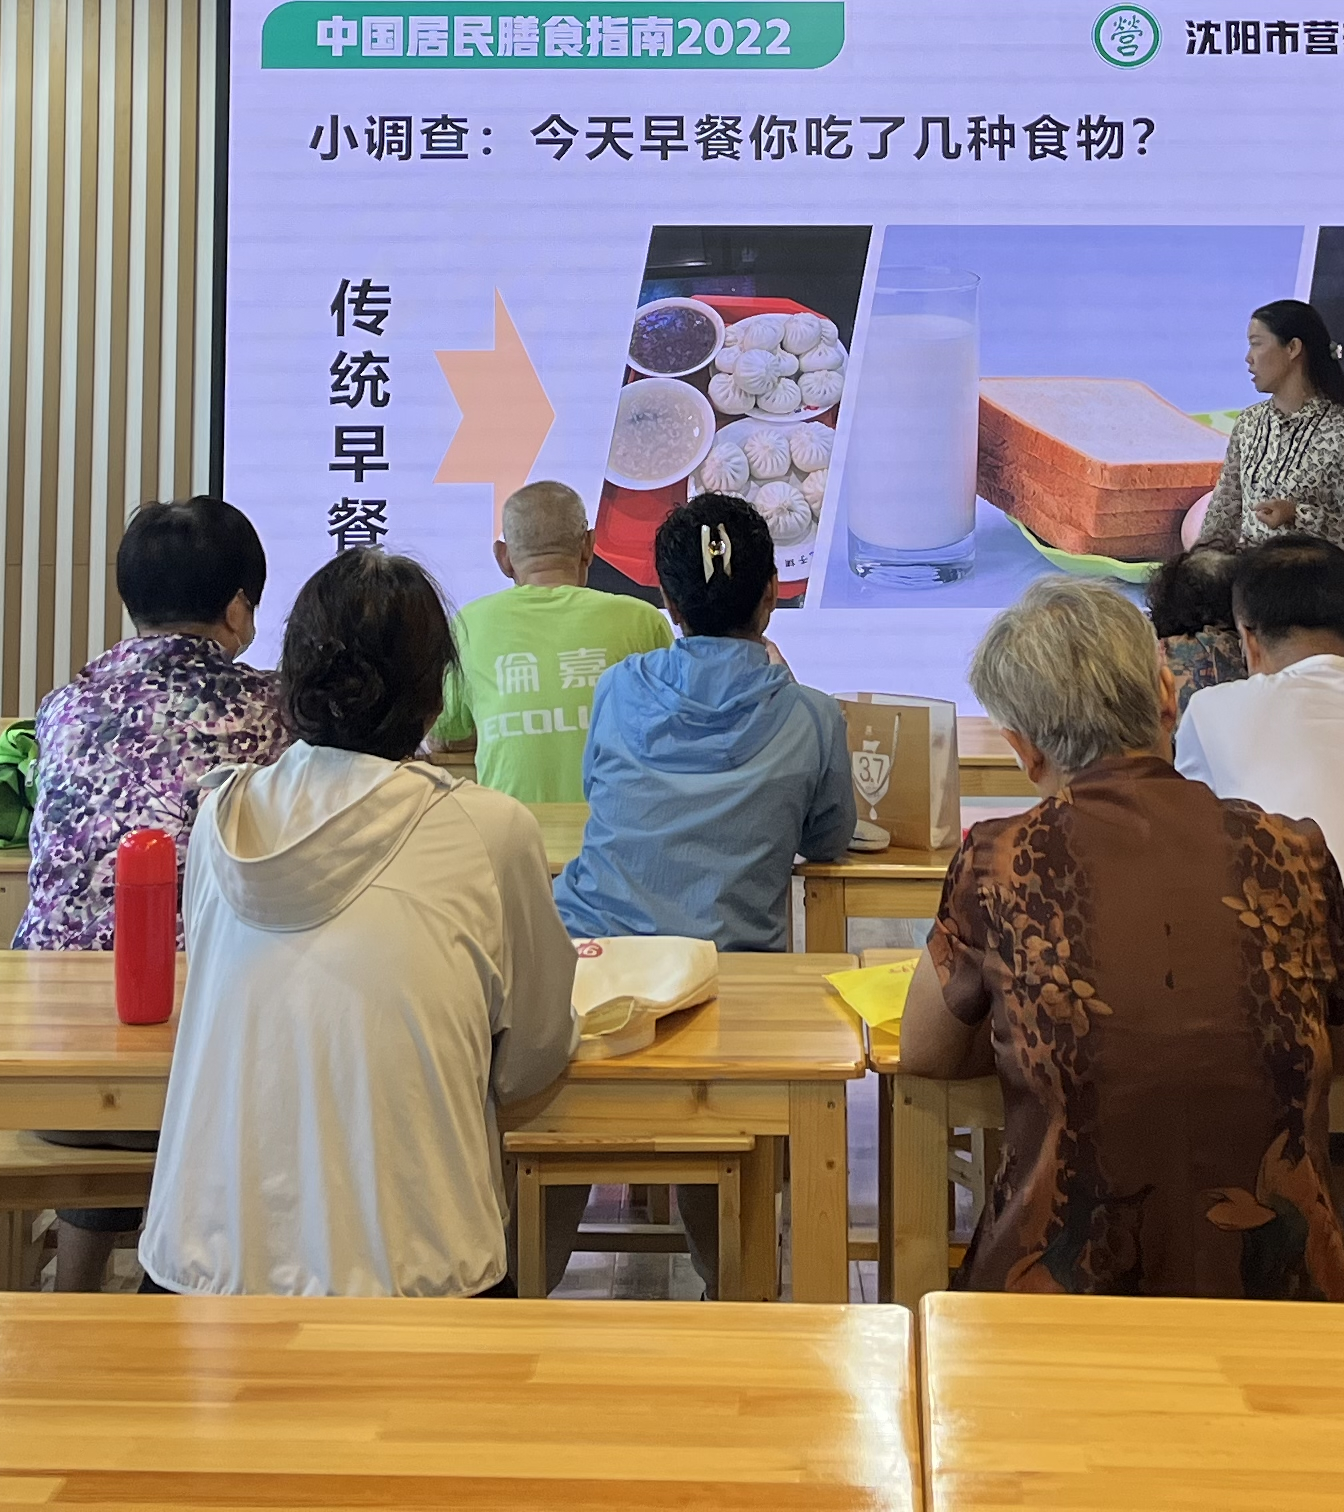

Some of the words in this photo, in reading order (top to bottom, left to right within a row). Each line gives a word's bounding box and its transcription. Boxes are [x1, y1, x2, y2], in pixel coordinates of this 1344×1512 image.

[316, 15, 792, 58] 中国居民膳食指南2022
[309, 113, 1155, 163] 小调查：今天早餐你吃了几种食物？
[327, 278, 394, 554] 传统早餐
[859, 756, 884, 784] 3.7
